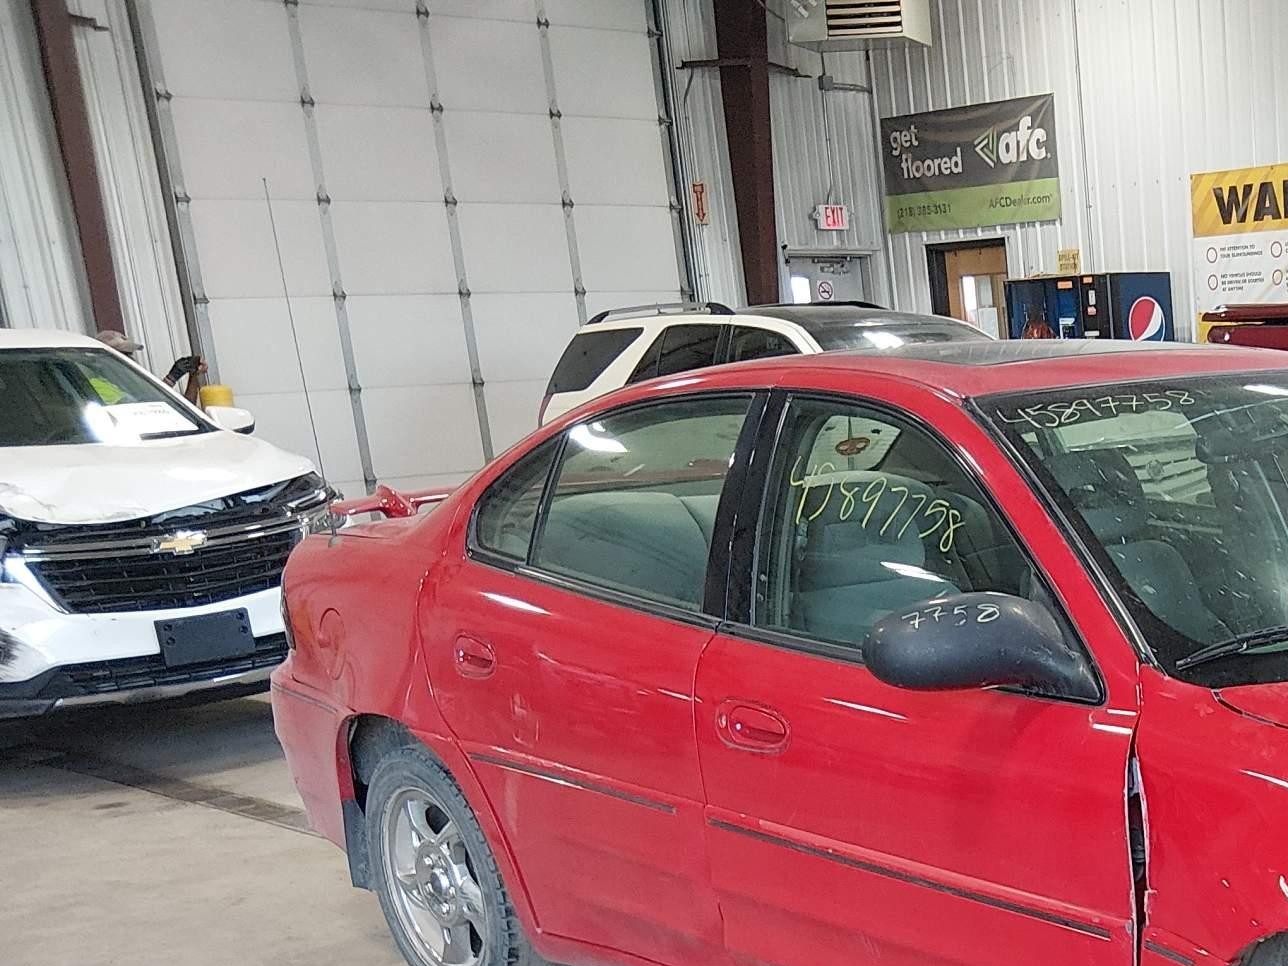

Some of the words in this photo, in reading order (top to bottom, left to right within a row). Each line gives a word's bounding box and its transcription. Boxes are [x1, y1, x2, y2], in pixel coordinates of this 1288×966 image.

[890, 125, 919, 156] get
[901, 147, 963, 179] floored
[824, 206, 845, 227] EXIT
[996, 390, 1195, 429] 45897758
[790, 455, 966, 553] 45897758
[901, 602, 1001, 630] 7758
